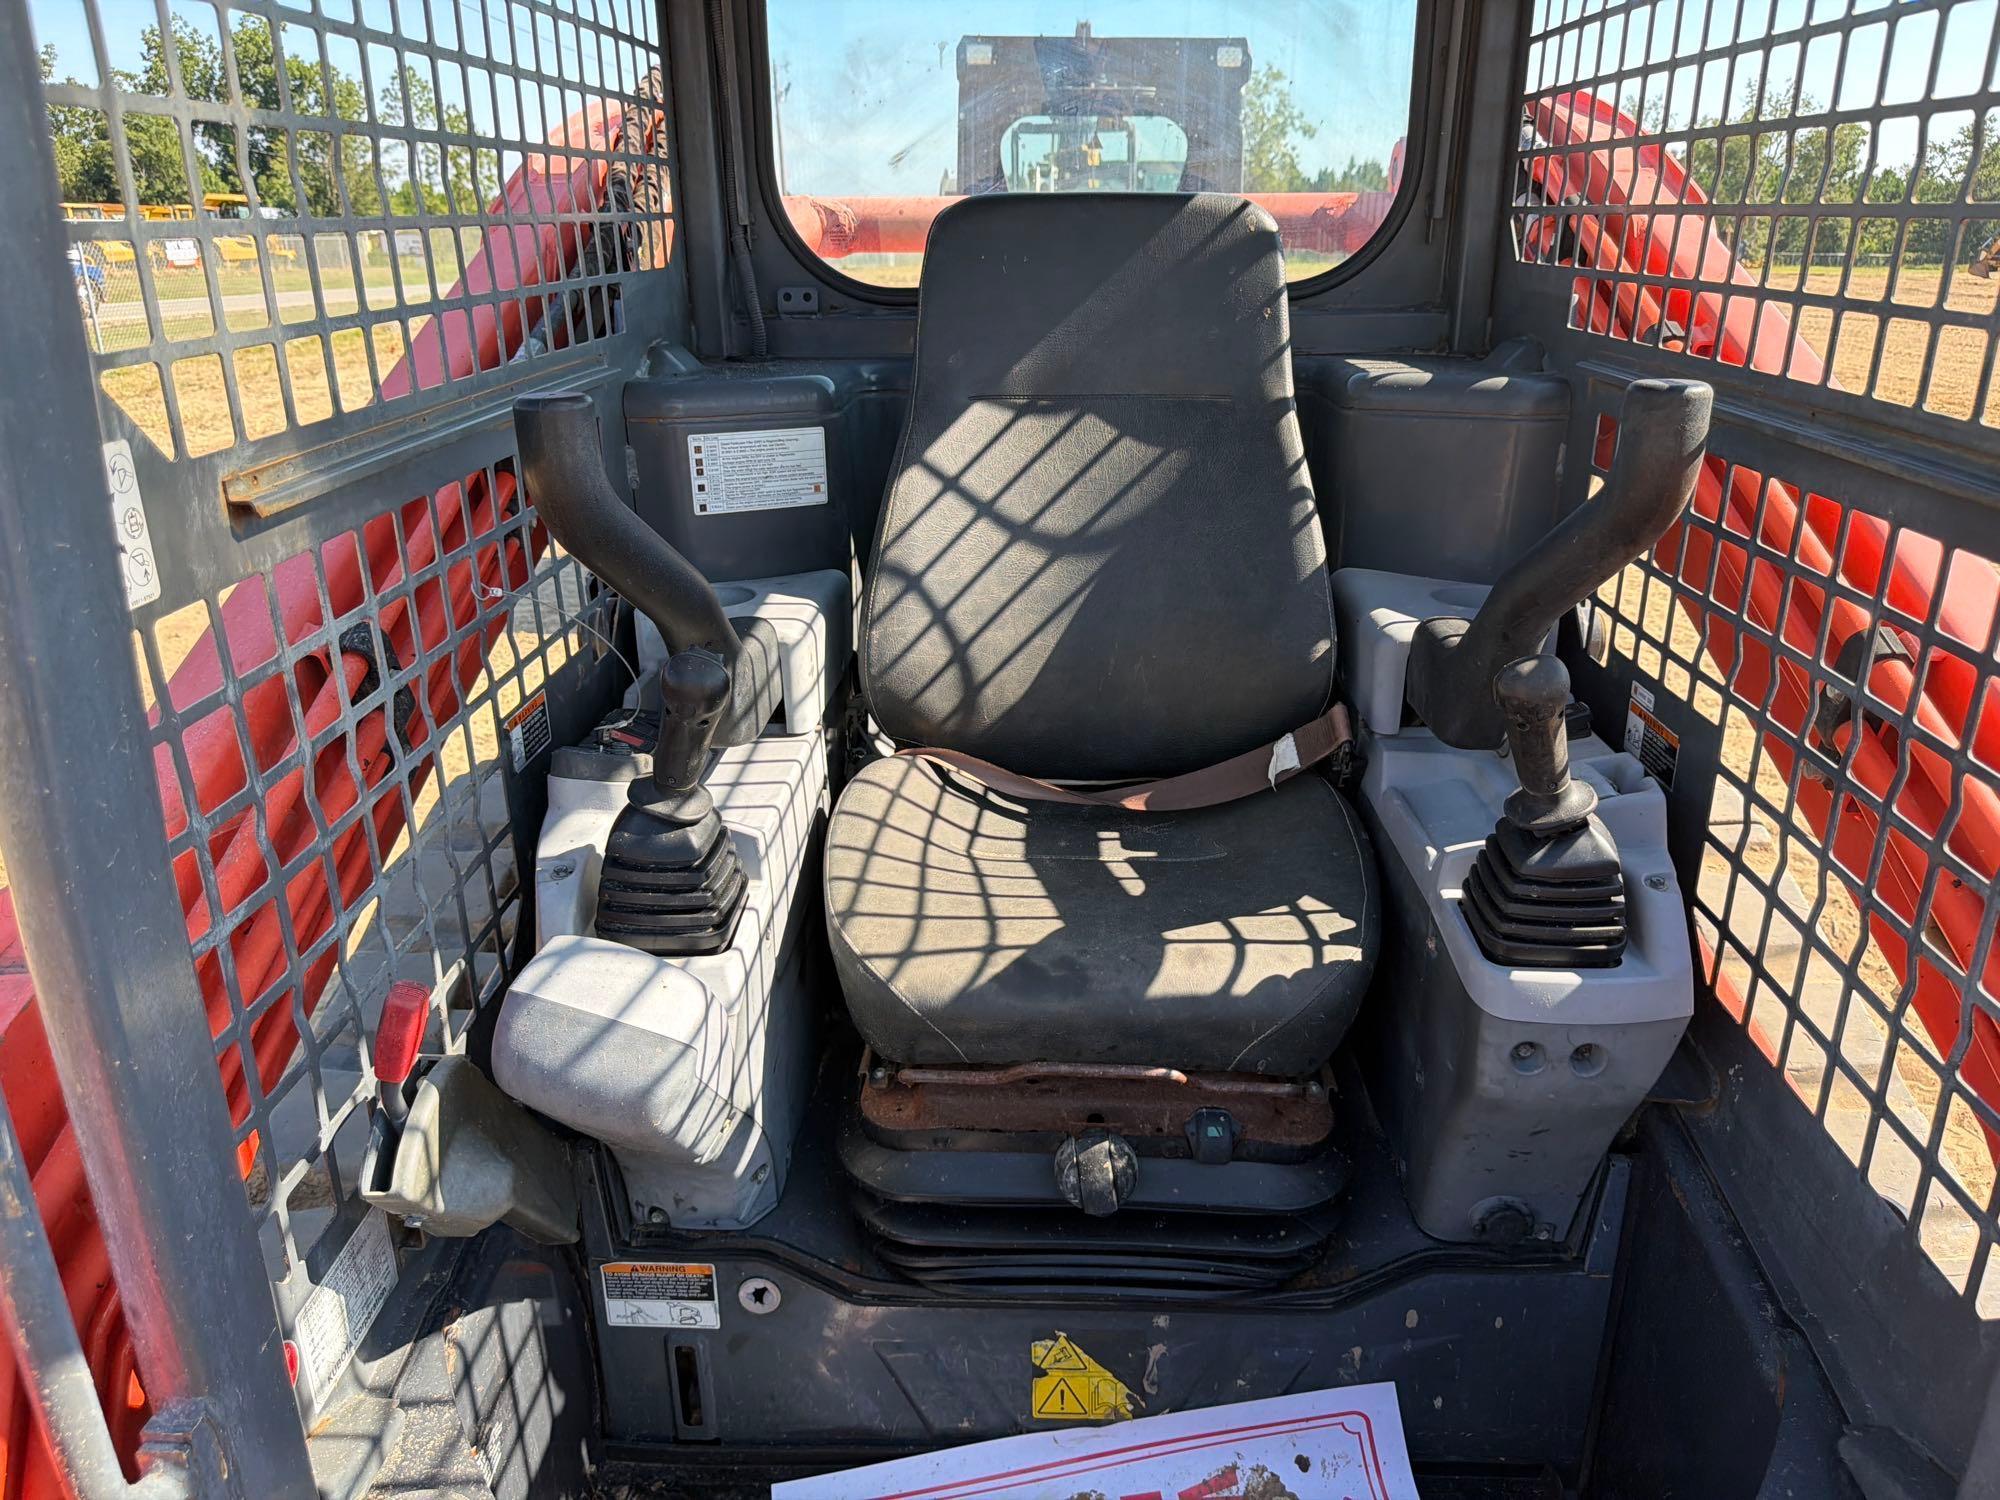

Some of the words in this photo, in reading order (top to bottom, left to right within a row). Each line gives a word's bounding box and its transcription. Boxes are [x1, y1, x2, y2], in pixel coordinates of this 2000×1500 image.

[639, 1265, 686, 1273] WARNING
[327, 1340, 354, 1385] KUBOTA
[353, 1286, 388, 1341] Corporation
